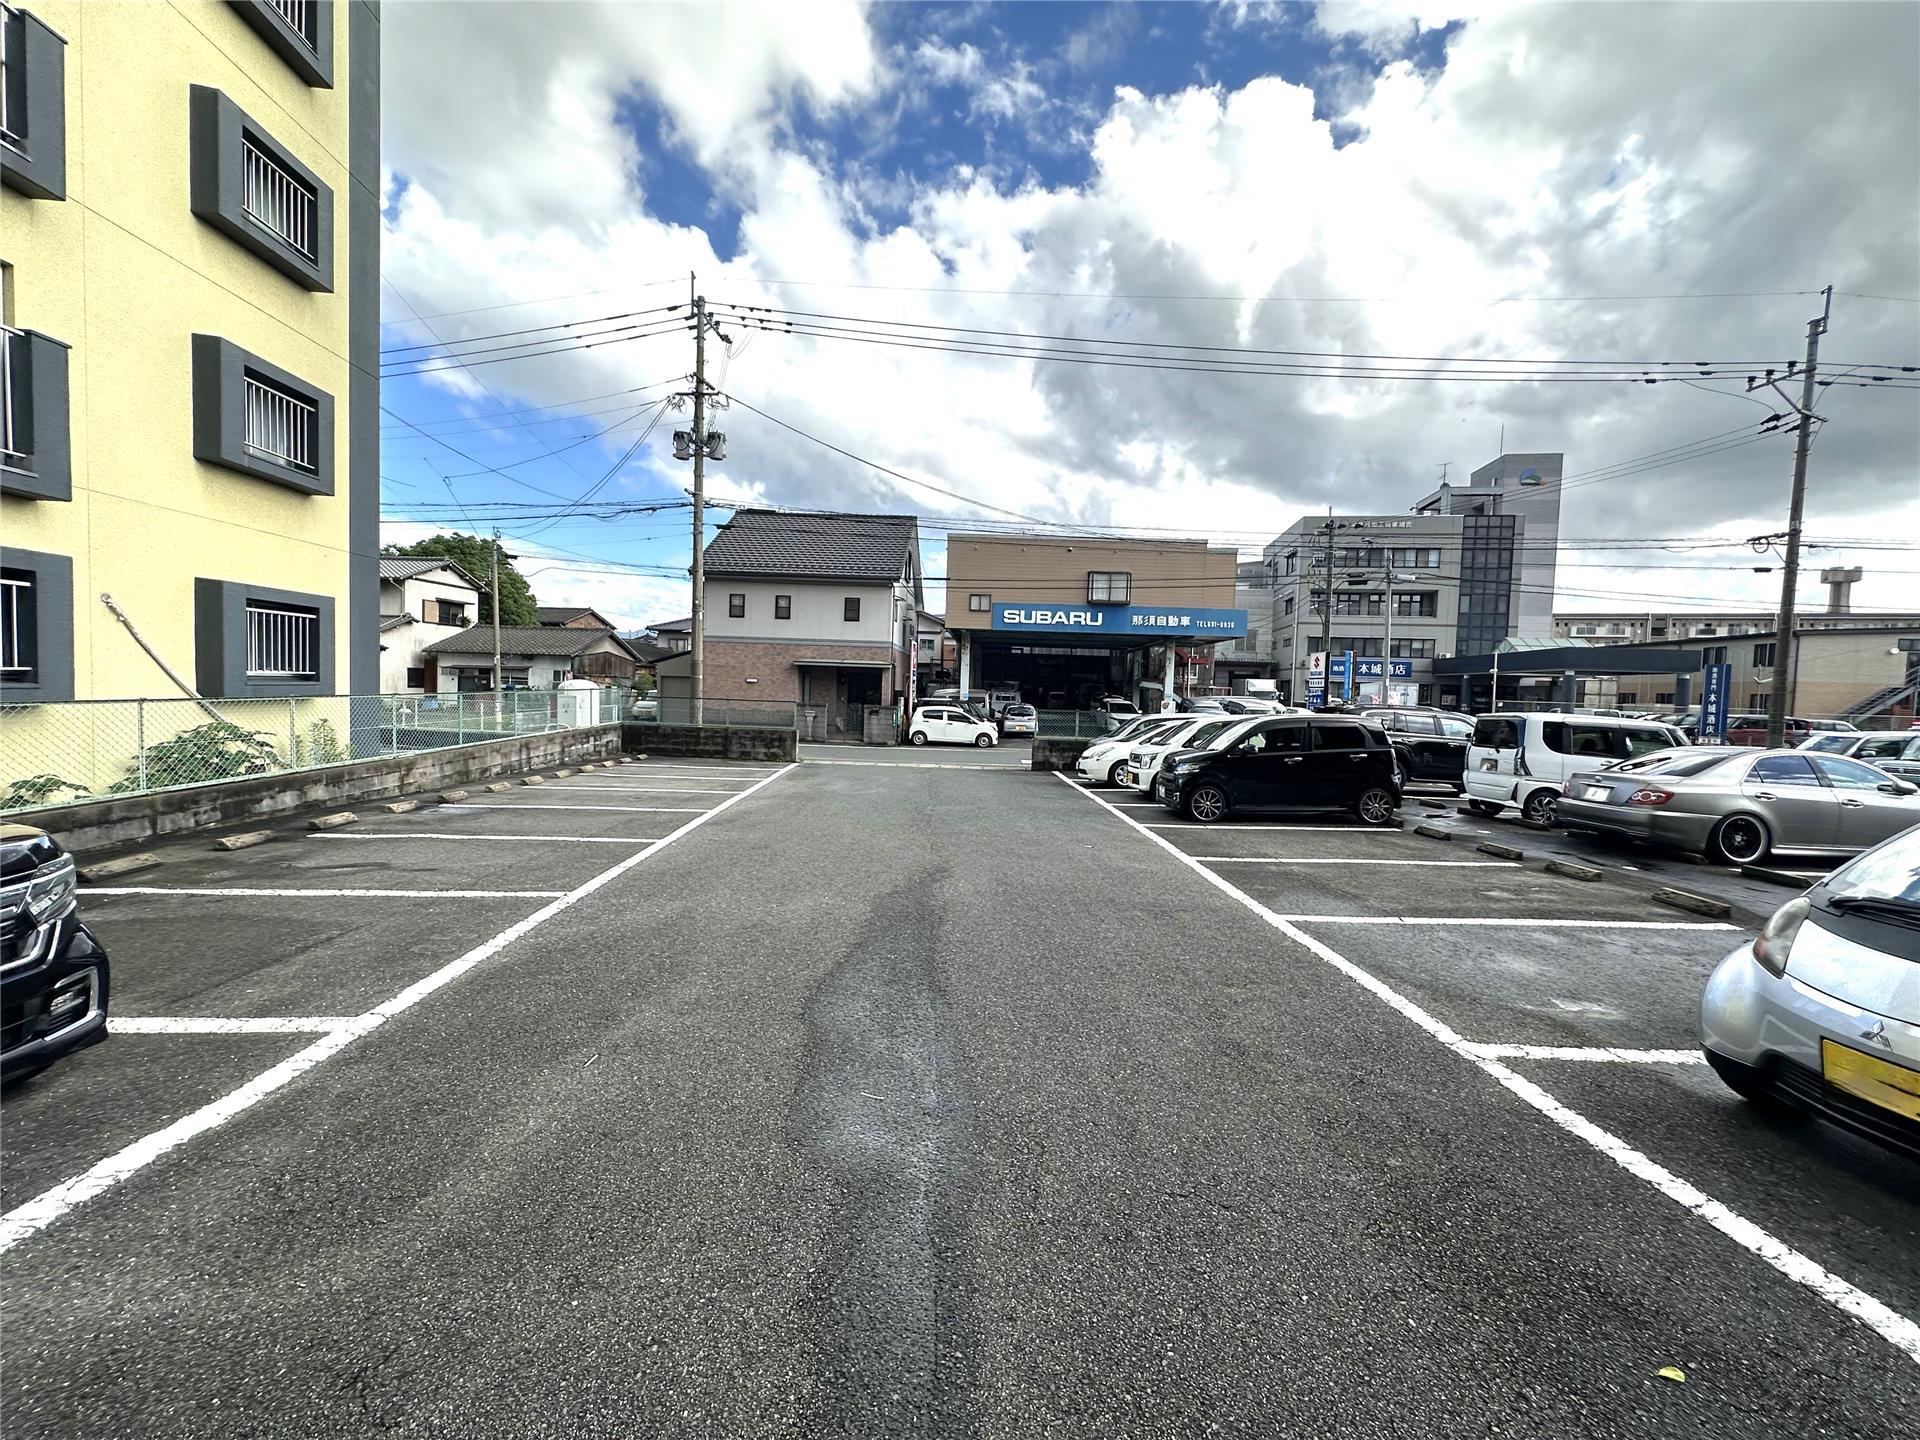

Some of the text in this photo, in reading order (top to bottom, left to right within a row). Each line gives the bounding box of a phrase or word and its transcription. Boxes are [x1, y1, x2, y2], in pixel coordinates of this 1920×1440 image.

[1003, 609, 1103, 626] SUBARU
[1131, 615, 1191, 627] 那須自動車
